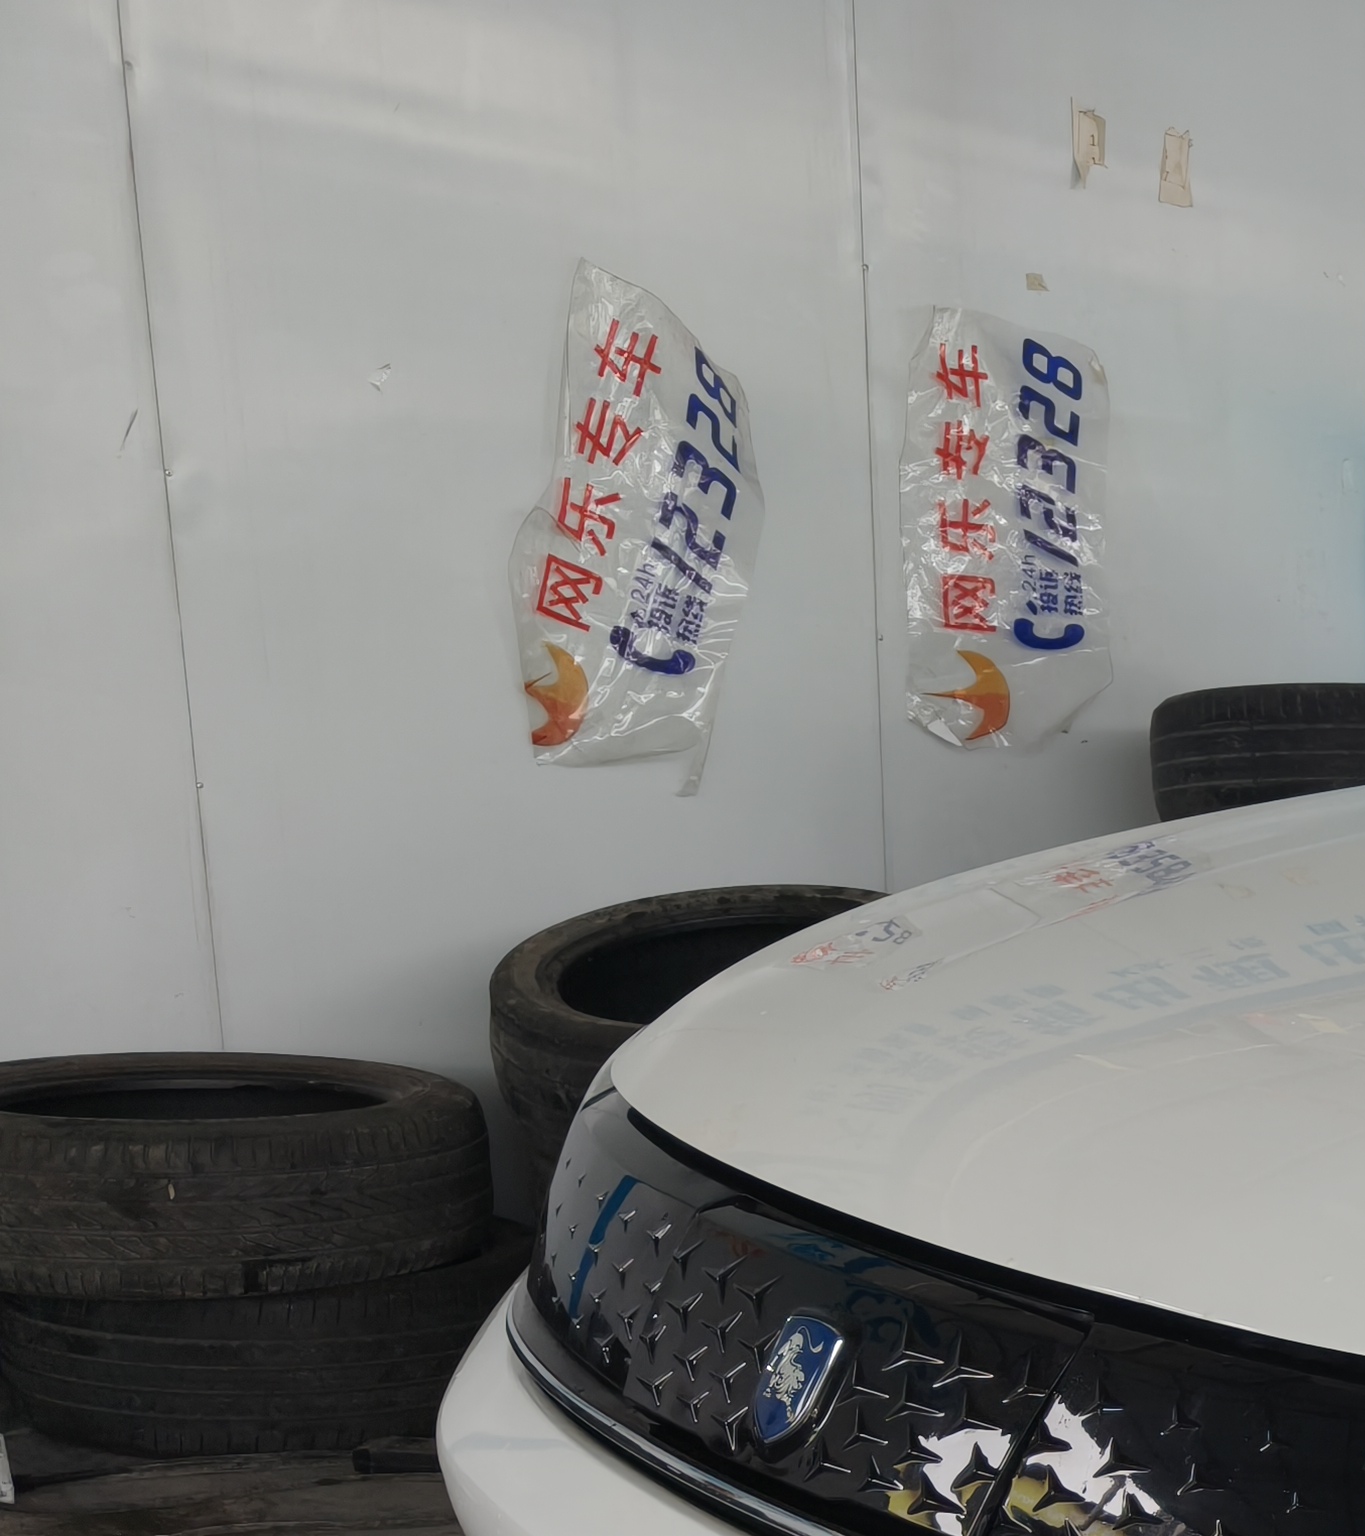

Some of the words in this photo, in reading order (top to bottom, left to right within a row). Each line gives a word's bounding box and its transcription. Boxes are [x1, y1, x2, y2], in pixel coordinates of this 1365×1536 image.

[536, 318, 661, 631] 网乐专车
[651, 346, 741, 594] 12328
[935, 343, 997, 632] 网乐专车
[1016, 338, 1083, 568] 12328
